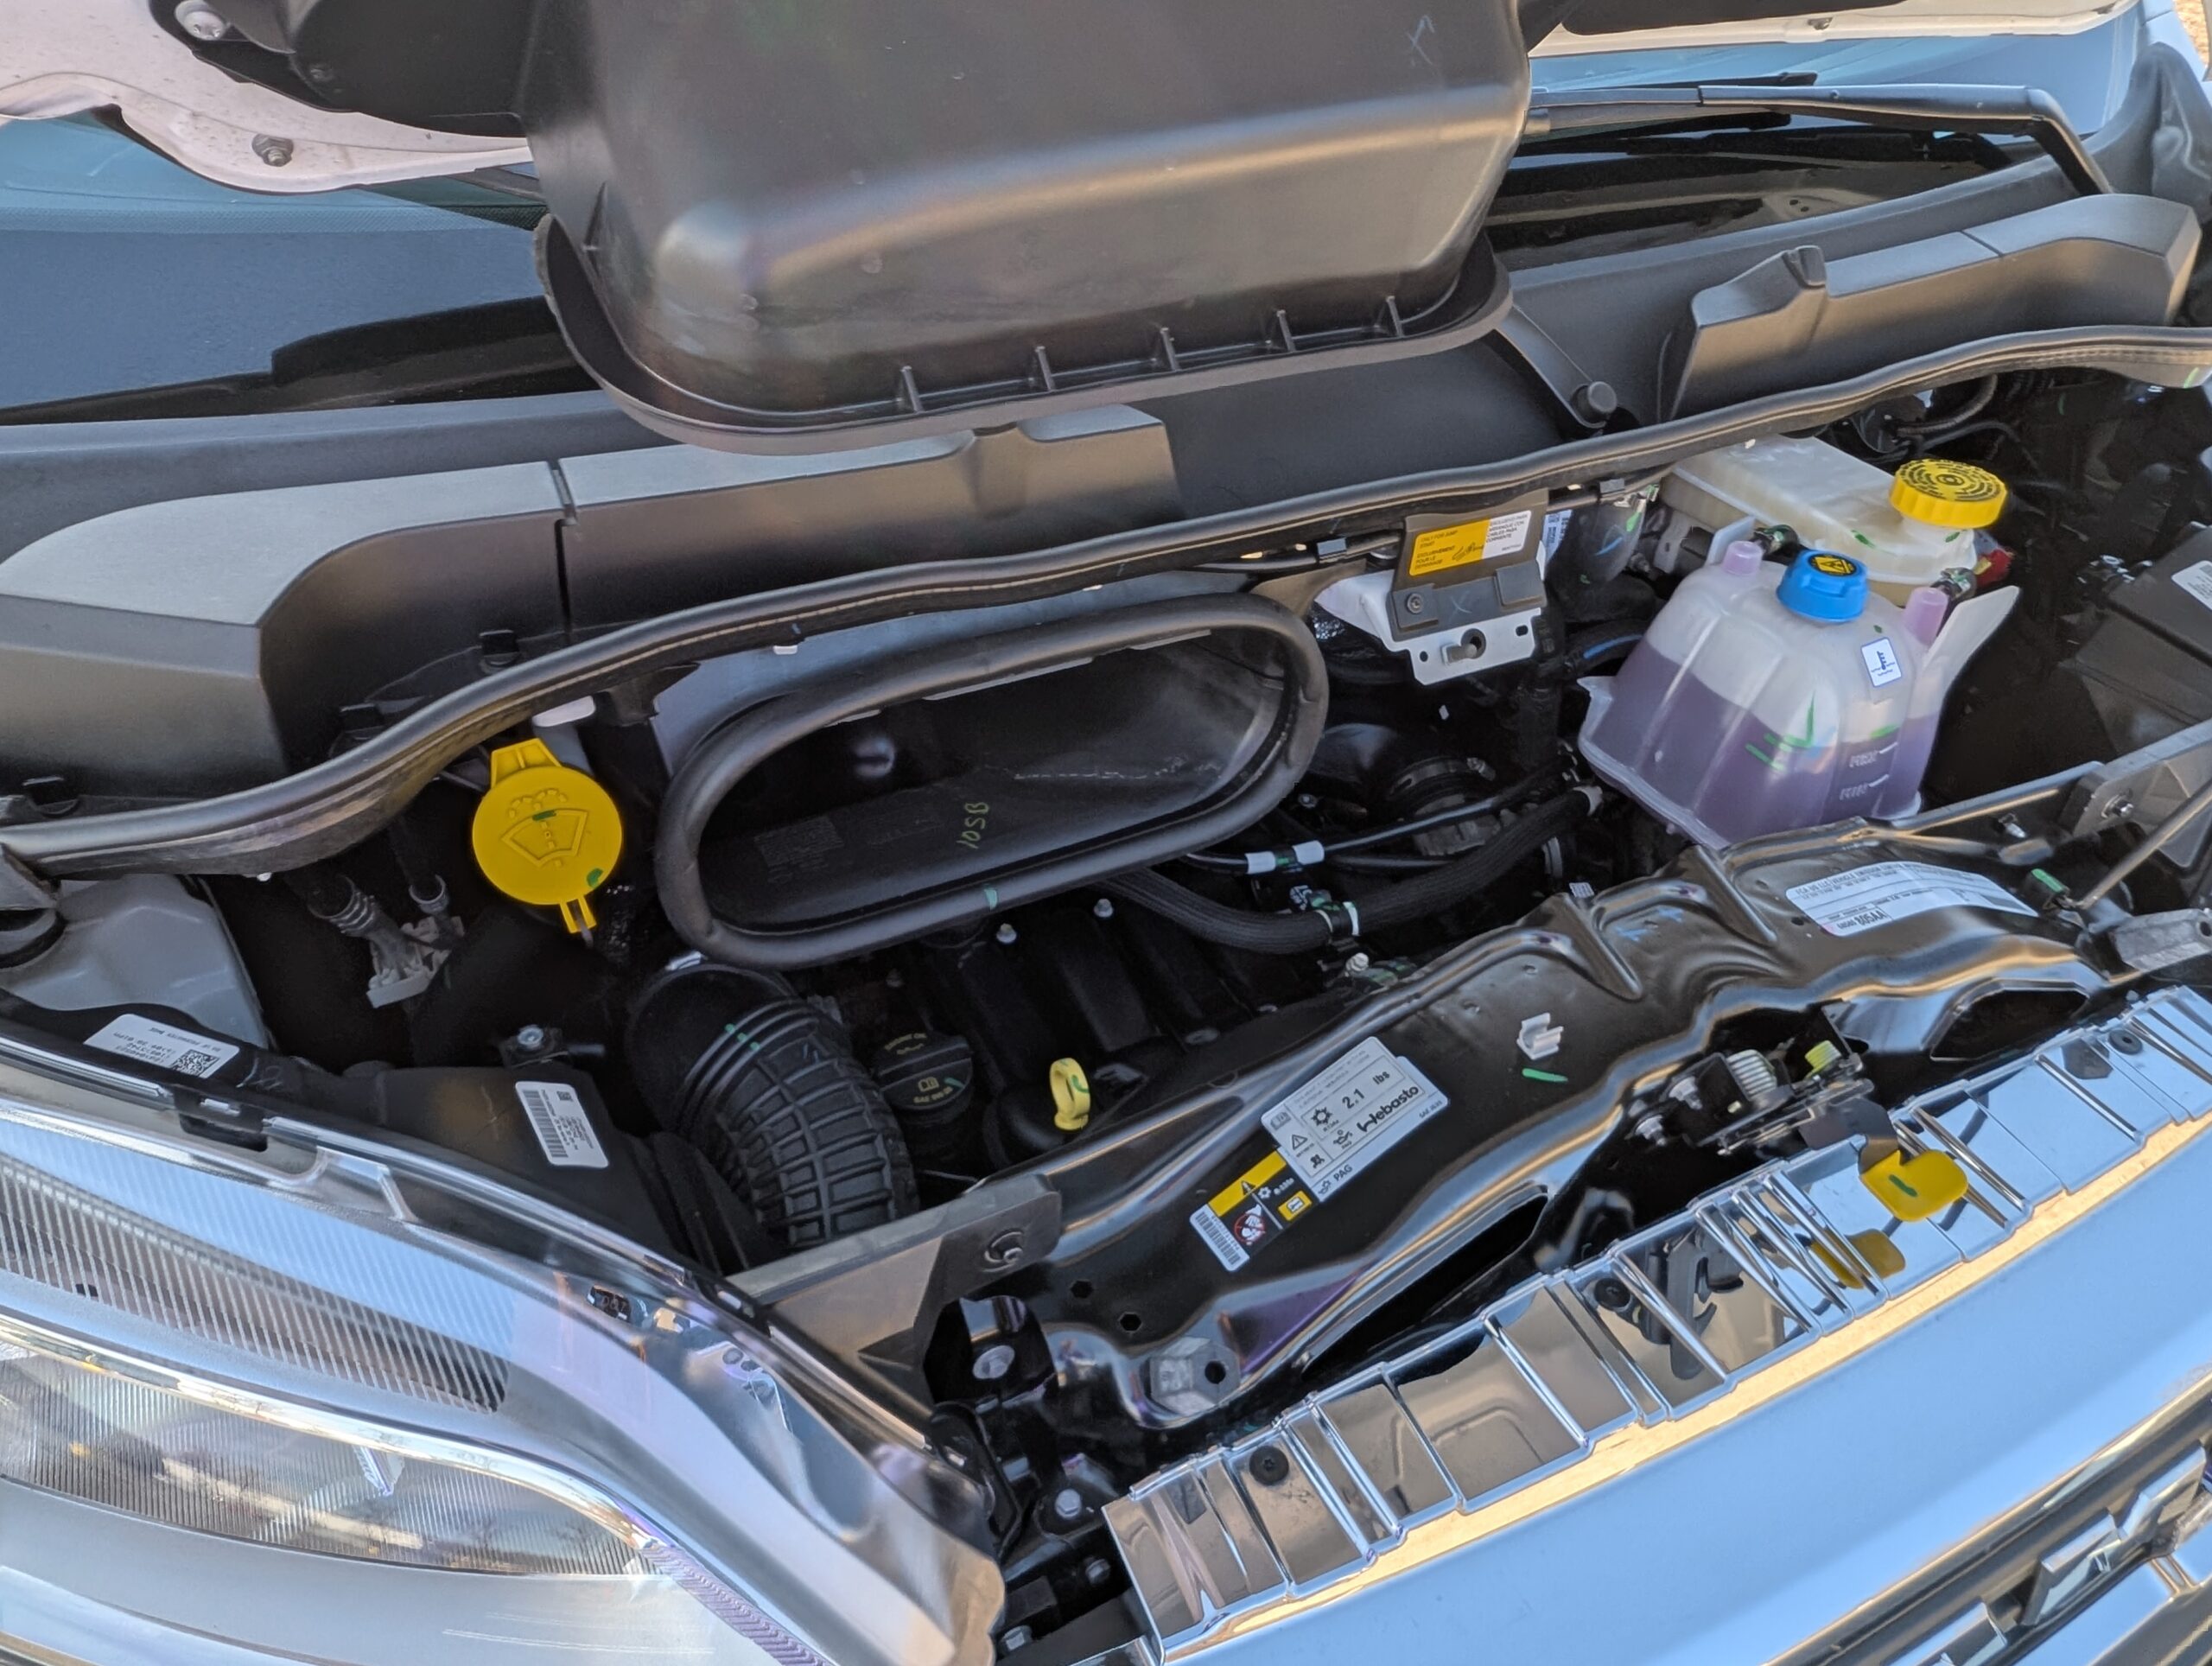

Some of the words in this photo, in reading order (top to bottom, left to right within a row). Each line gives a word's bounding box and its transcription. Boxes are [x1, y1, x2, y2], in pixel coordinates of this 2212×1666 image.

[1342, 1089, 1365, 1109] 2.1
[1371, 1069, 1390, 1084] lbs
[1357, 1085, 1419, 1132] Webasto
[1333, 1164, 1353, 1181] PAG
